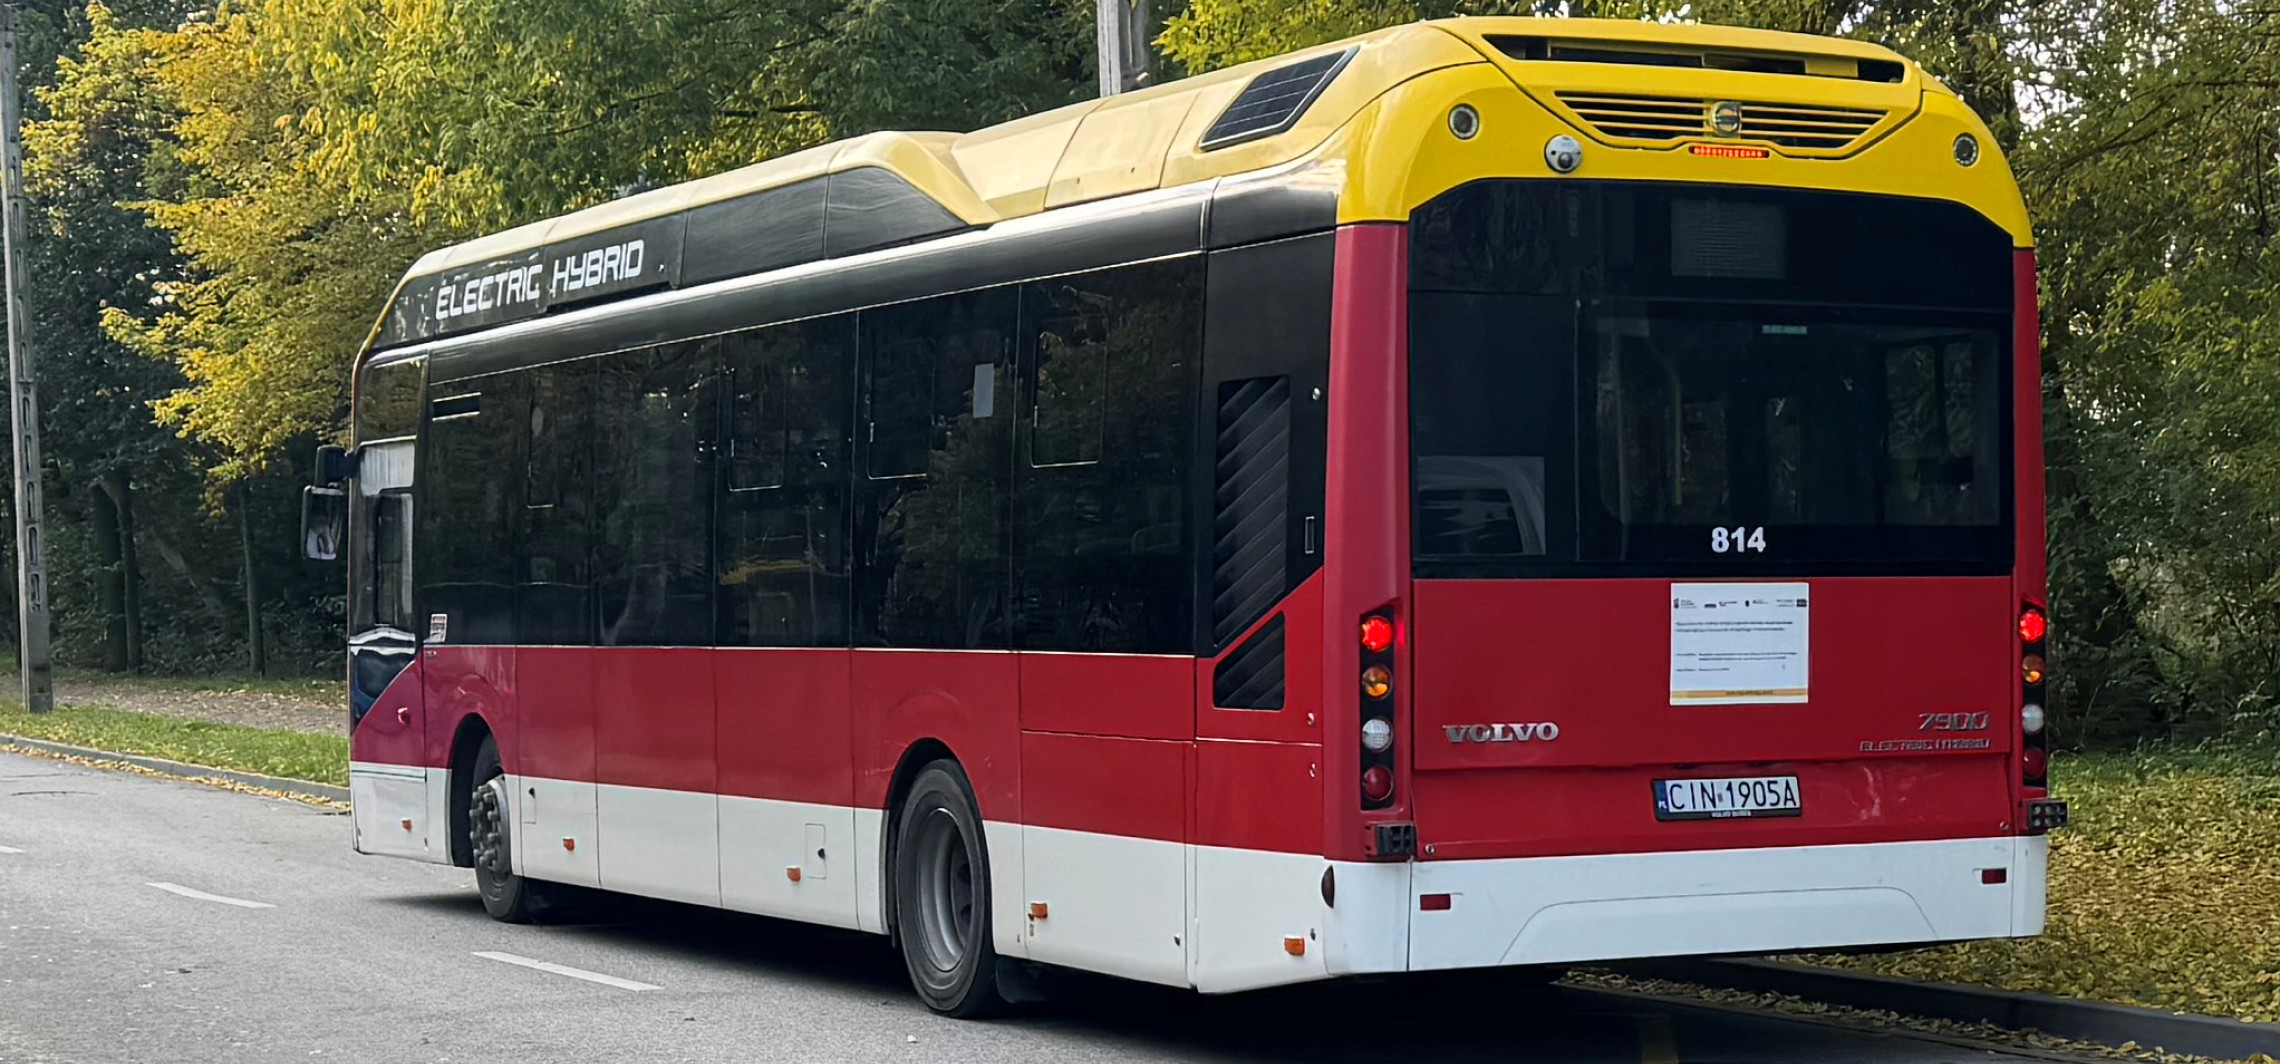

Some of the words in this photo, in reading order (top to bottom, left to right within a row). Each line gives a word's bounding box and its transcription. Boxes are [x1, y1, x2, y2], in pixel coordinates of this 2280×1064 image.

[436, 264, 542, 320] ELECTRIC
[552, 239, 645, 298] HYBRID
[1712, 526, 1766, 553] 814
[1442, 722, 1559, 742] VOLVO
[1918, 711, 1989, 730] 7900
[1669, 783, 1717, 809] CIN
[1726, 779, 1797, 808] 1905A
